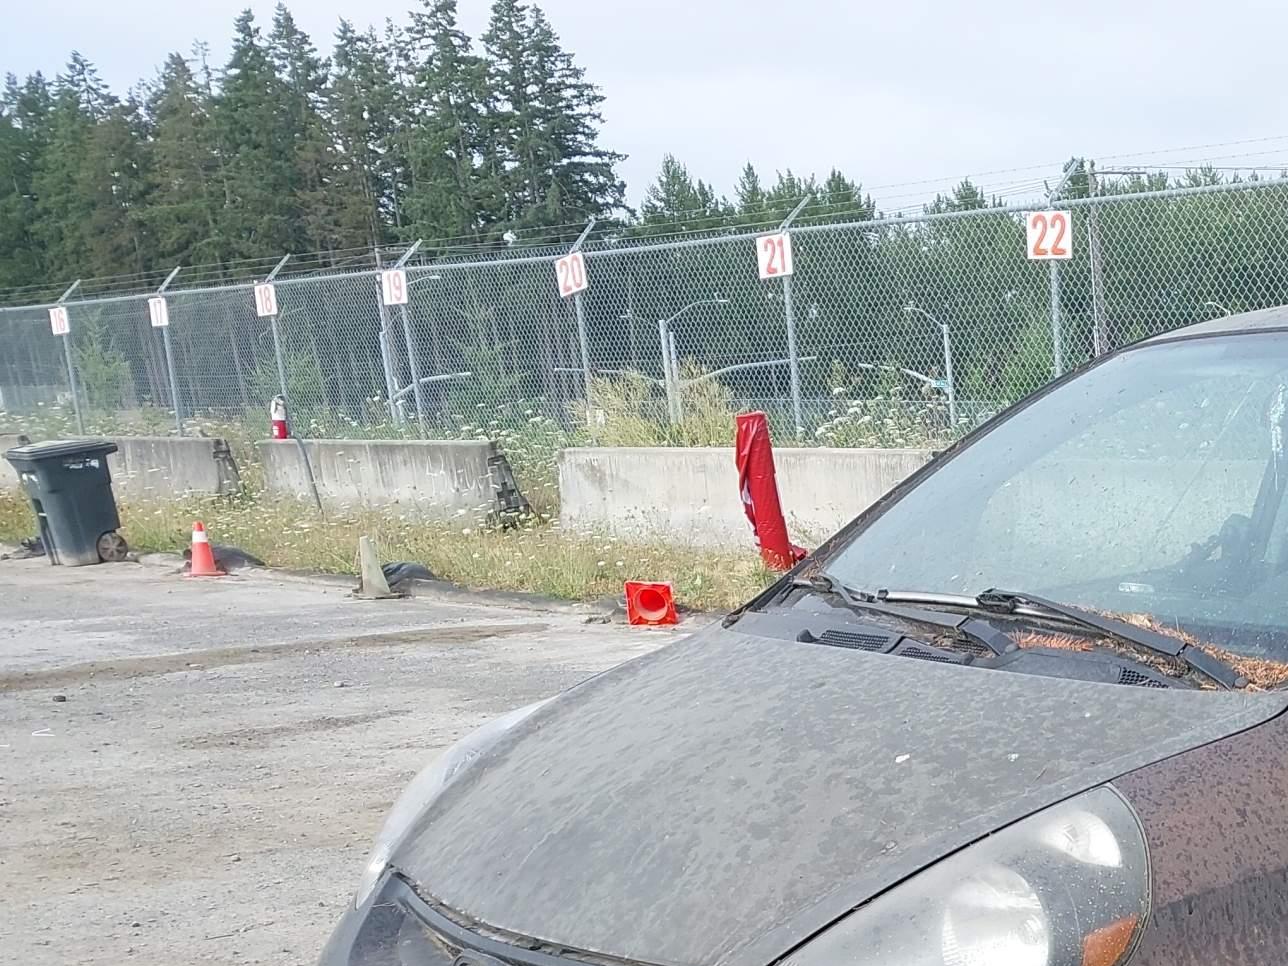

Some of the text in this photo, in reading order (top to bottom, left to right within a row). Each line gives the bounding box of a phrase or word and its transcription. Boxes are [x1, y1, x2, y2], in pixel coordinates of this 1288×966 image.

[1031, 213, 1067, 257] 22
[764, 239, 784, 275] 21
[387, 271, 403, 301] 19
[559, 255, 583, 293] 20
[153, 301, 164, 325] 17
[257, 286, 271, 315] 18
[54, 310, 65, 333] 16
